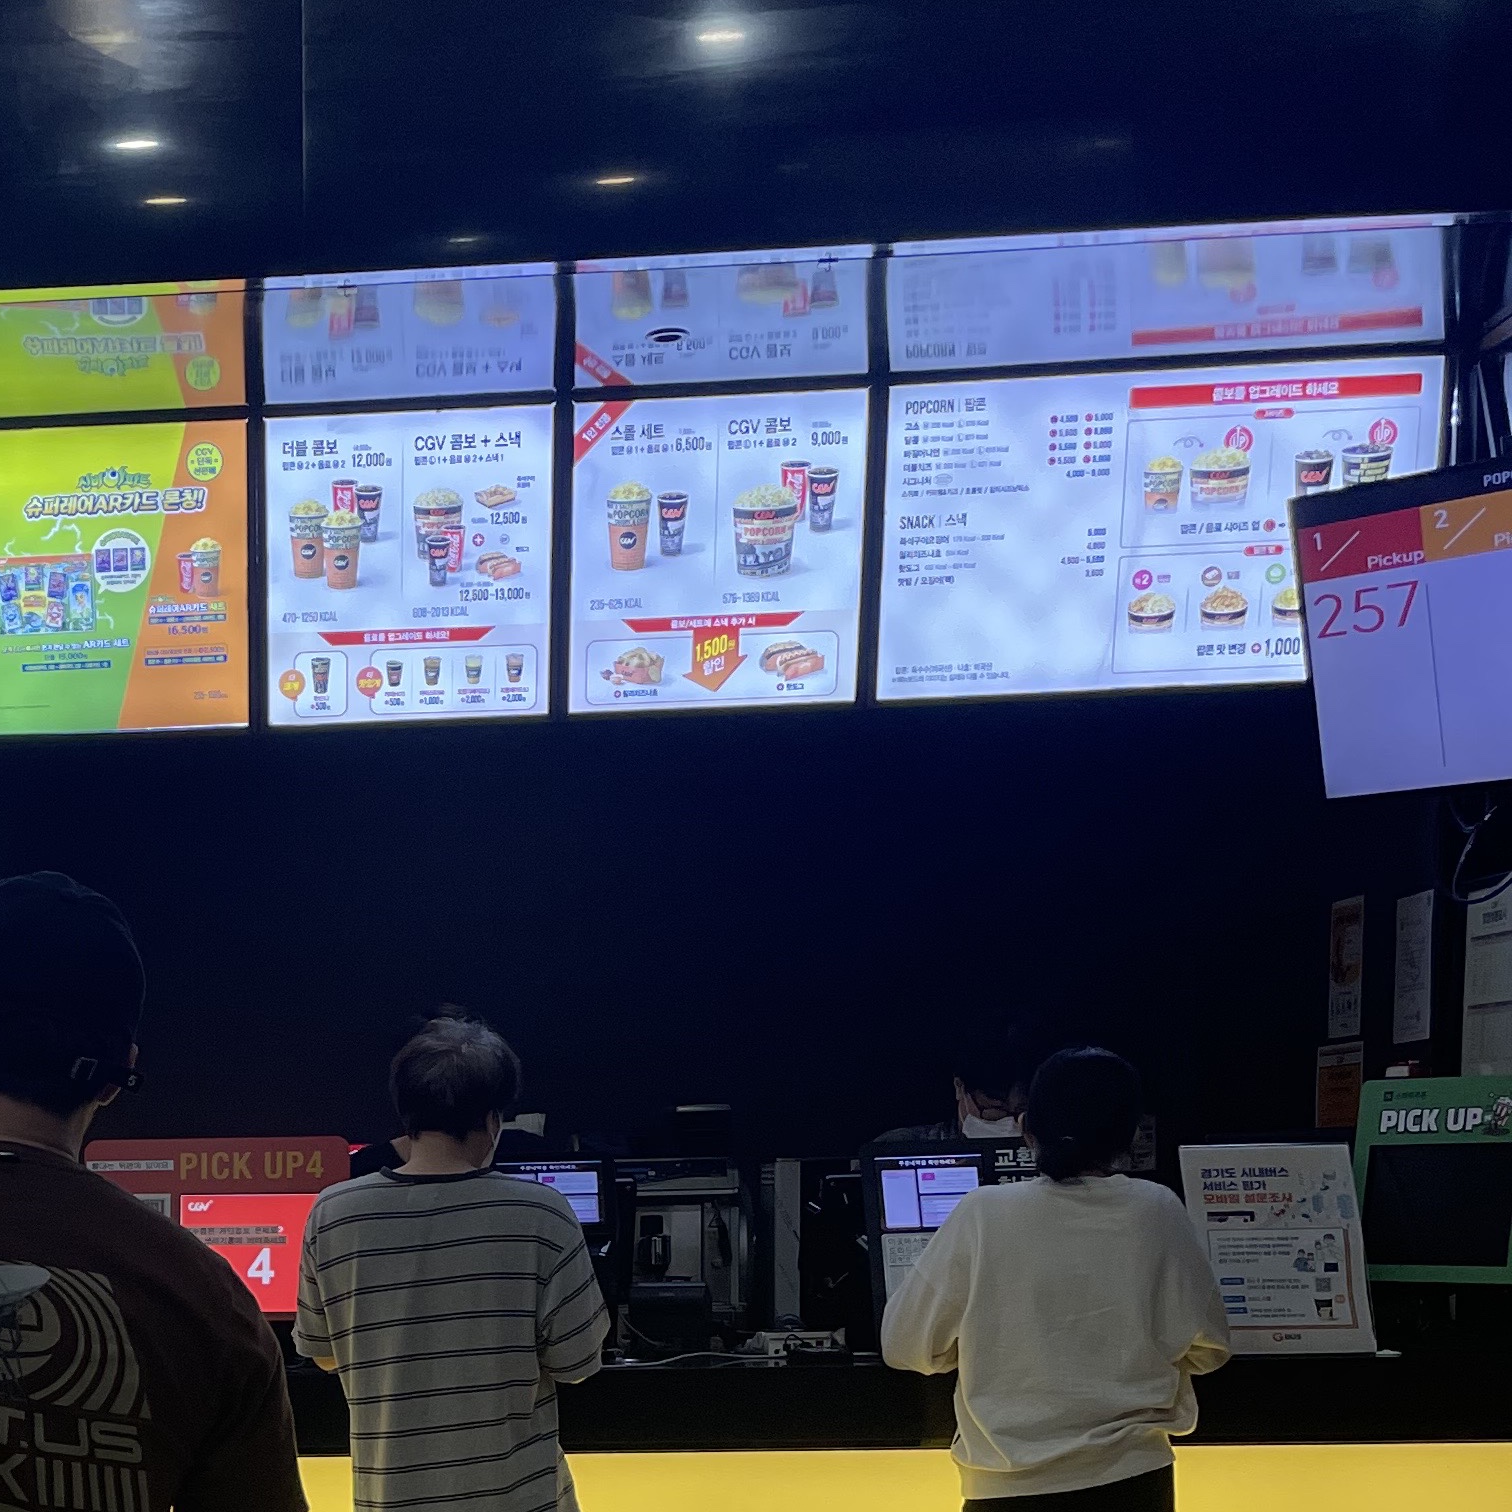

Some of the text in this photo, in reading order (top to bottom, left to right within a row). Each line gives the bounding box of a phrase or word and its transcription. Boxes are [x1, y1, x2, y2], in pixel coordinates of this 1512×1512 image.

[1248, 381, 1304, 400] 업그레이드
[1305, 379, 1340, 398] 하세요
[904, 399, 956, 415] POPCORN
[639, 423, 666, 440] 세트
[728, 416, 793, 436] CGV 콤보
[283, 438, 339, 458] 더블 콤보
[414, 434, 447, 452] CGV
[450, 432, 477, 451] 콤보
[494, 430, 522, 449] 스낵
[24, 490, 160, 519] 슈퍼레어AR카드
[899, 512, 968, 531] SNACK 스낵
[1433, 509, 1449, 530] 2
[1313, 532, 1324, 551] 1
[1366, 549, 1425, 571] Pickup
[1313, 580, 1419, 640] 257
[695, 634, 737, 663] 1,500원
[1379, 1107, 1485, 1135] PICK UP
[178, 1150, 325, 1180] PICK UP4
[994, 1146, 1038, 1168] 교환
[1200, 1166, 1290, 1179] 경기도 시내버스
[1202, 1180, 1239, 1192] 서비스
[1243, 1191, 1294, 1205] 설문조사
[246, 1247, 275, 1285] 4
